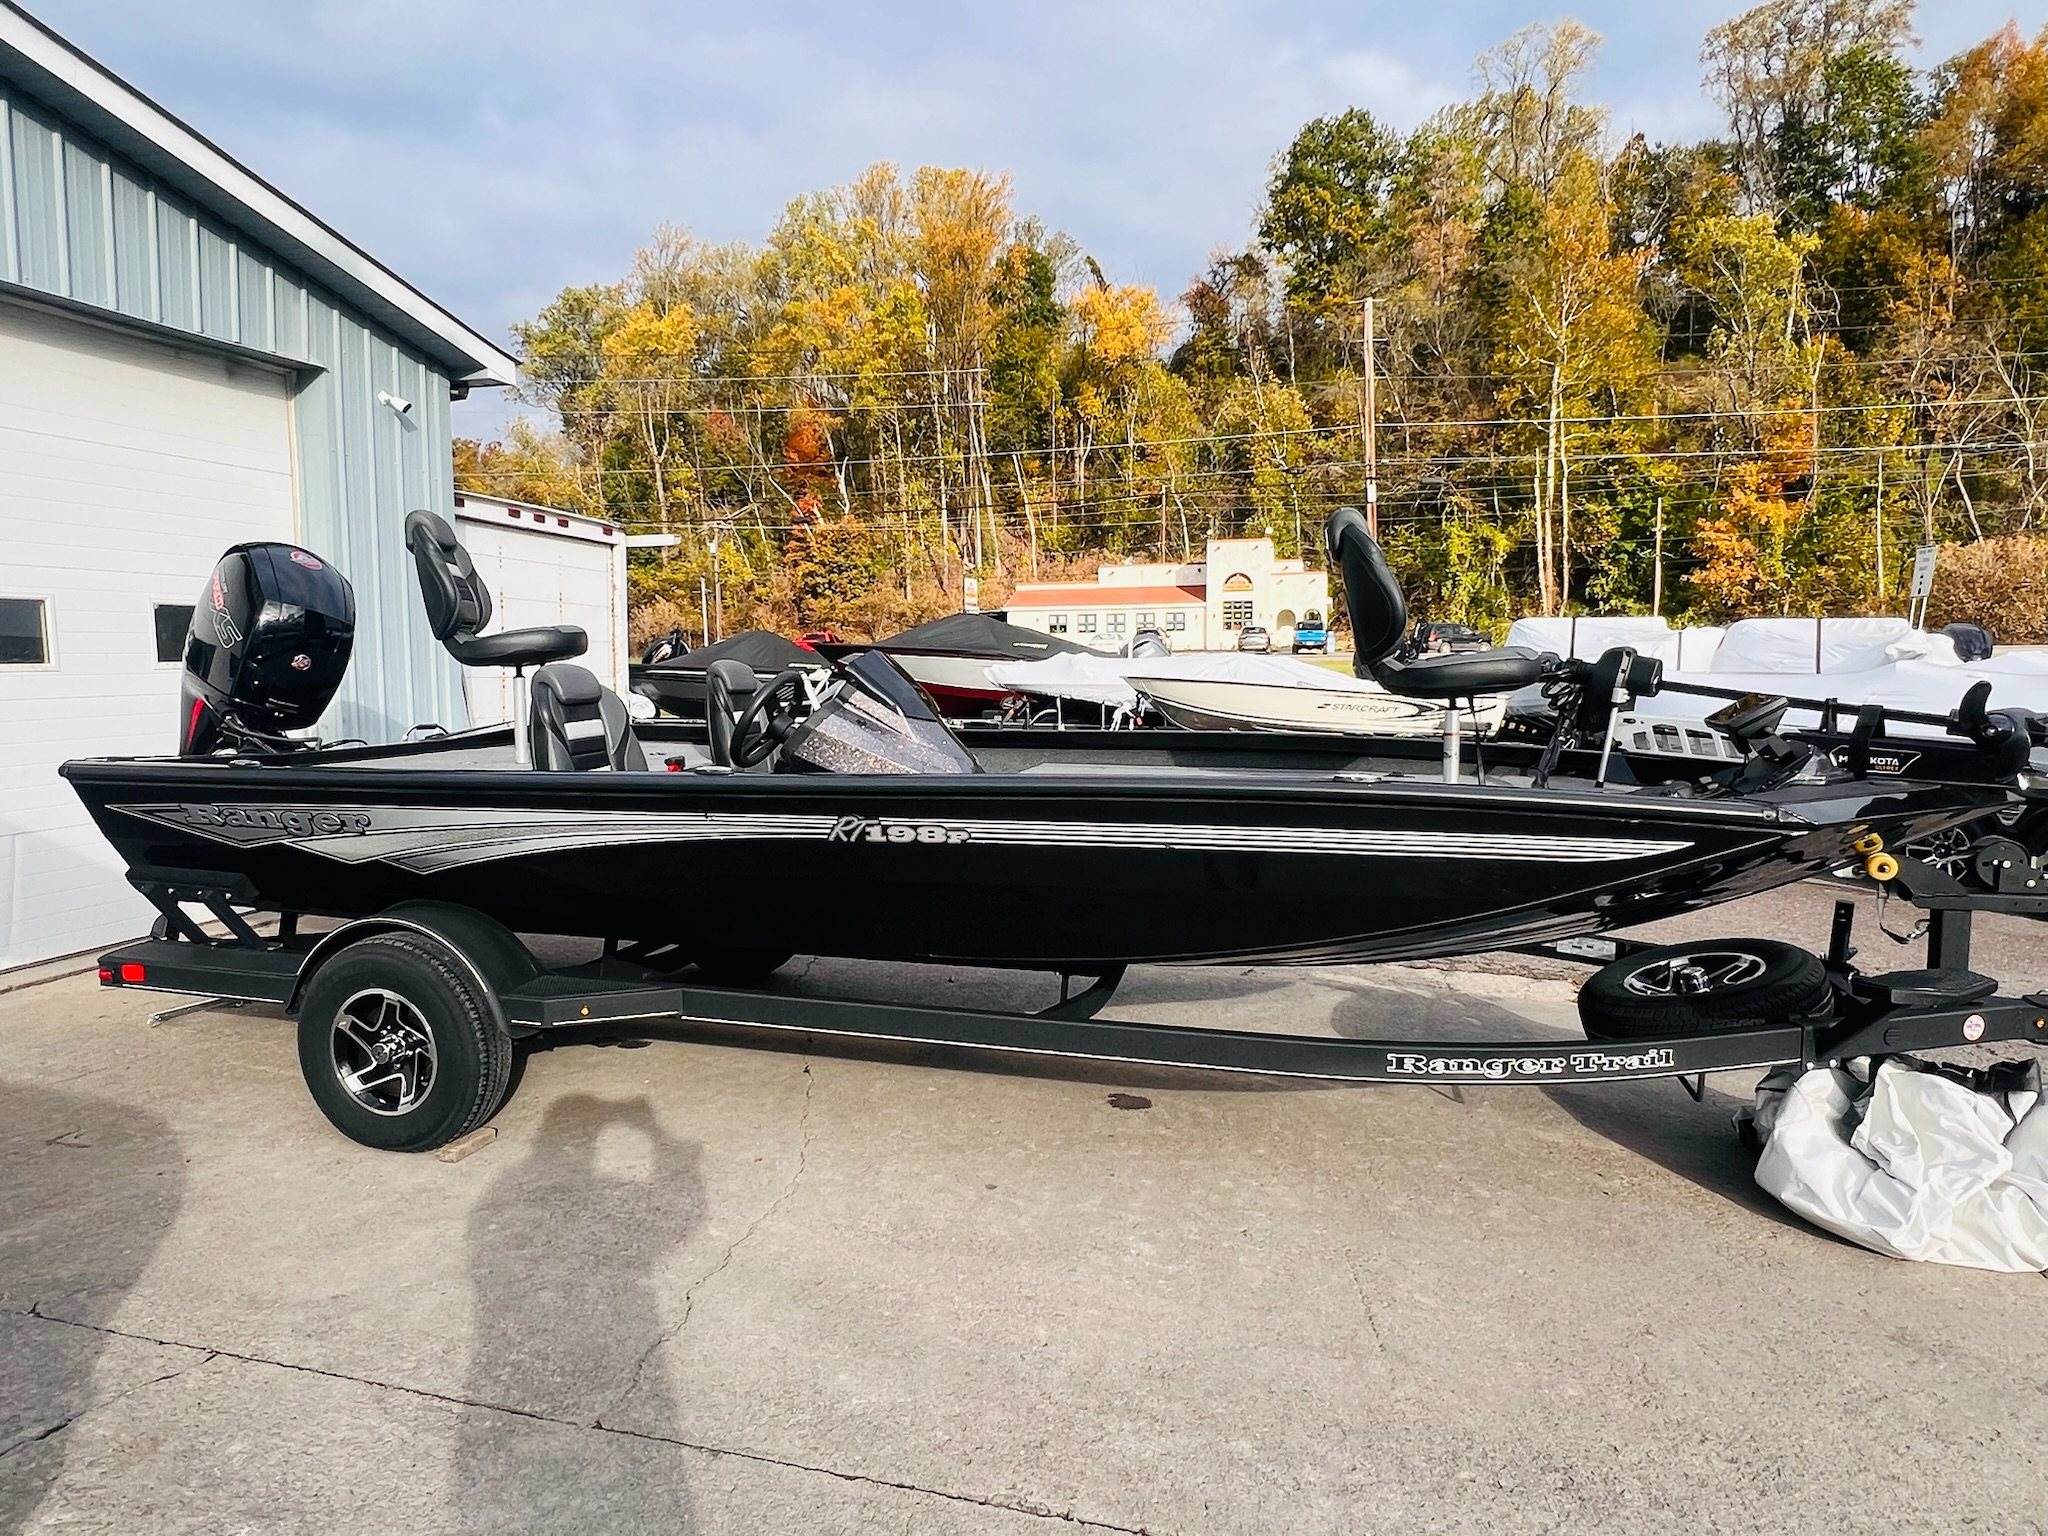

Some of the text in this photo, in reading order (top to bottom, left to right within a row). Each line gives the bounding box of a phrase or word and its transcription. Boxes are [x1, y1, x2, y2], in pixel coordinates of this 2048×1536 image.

[1331, 703, 1399, 714] STARCRAFT
[1869, 757, 1900, 766] KOTA
[179, 803, 371, 836] Ranger
[1386, 1049, 1675, 1079] Ranger Trail
